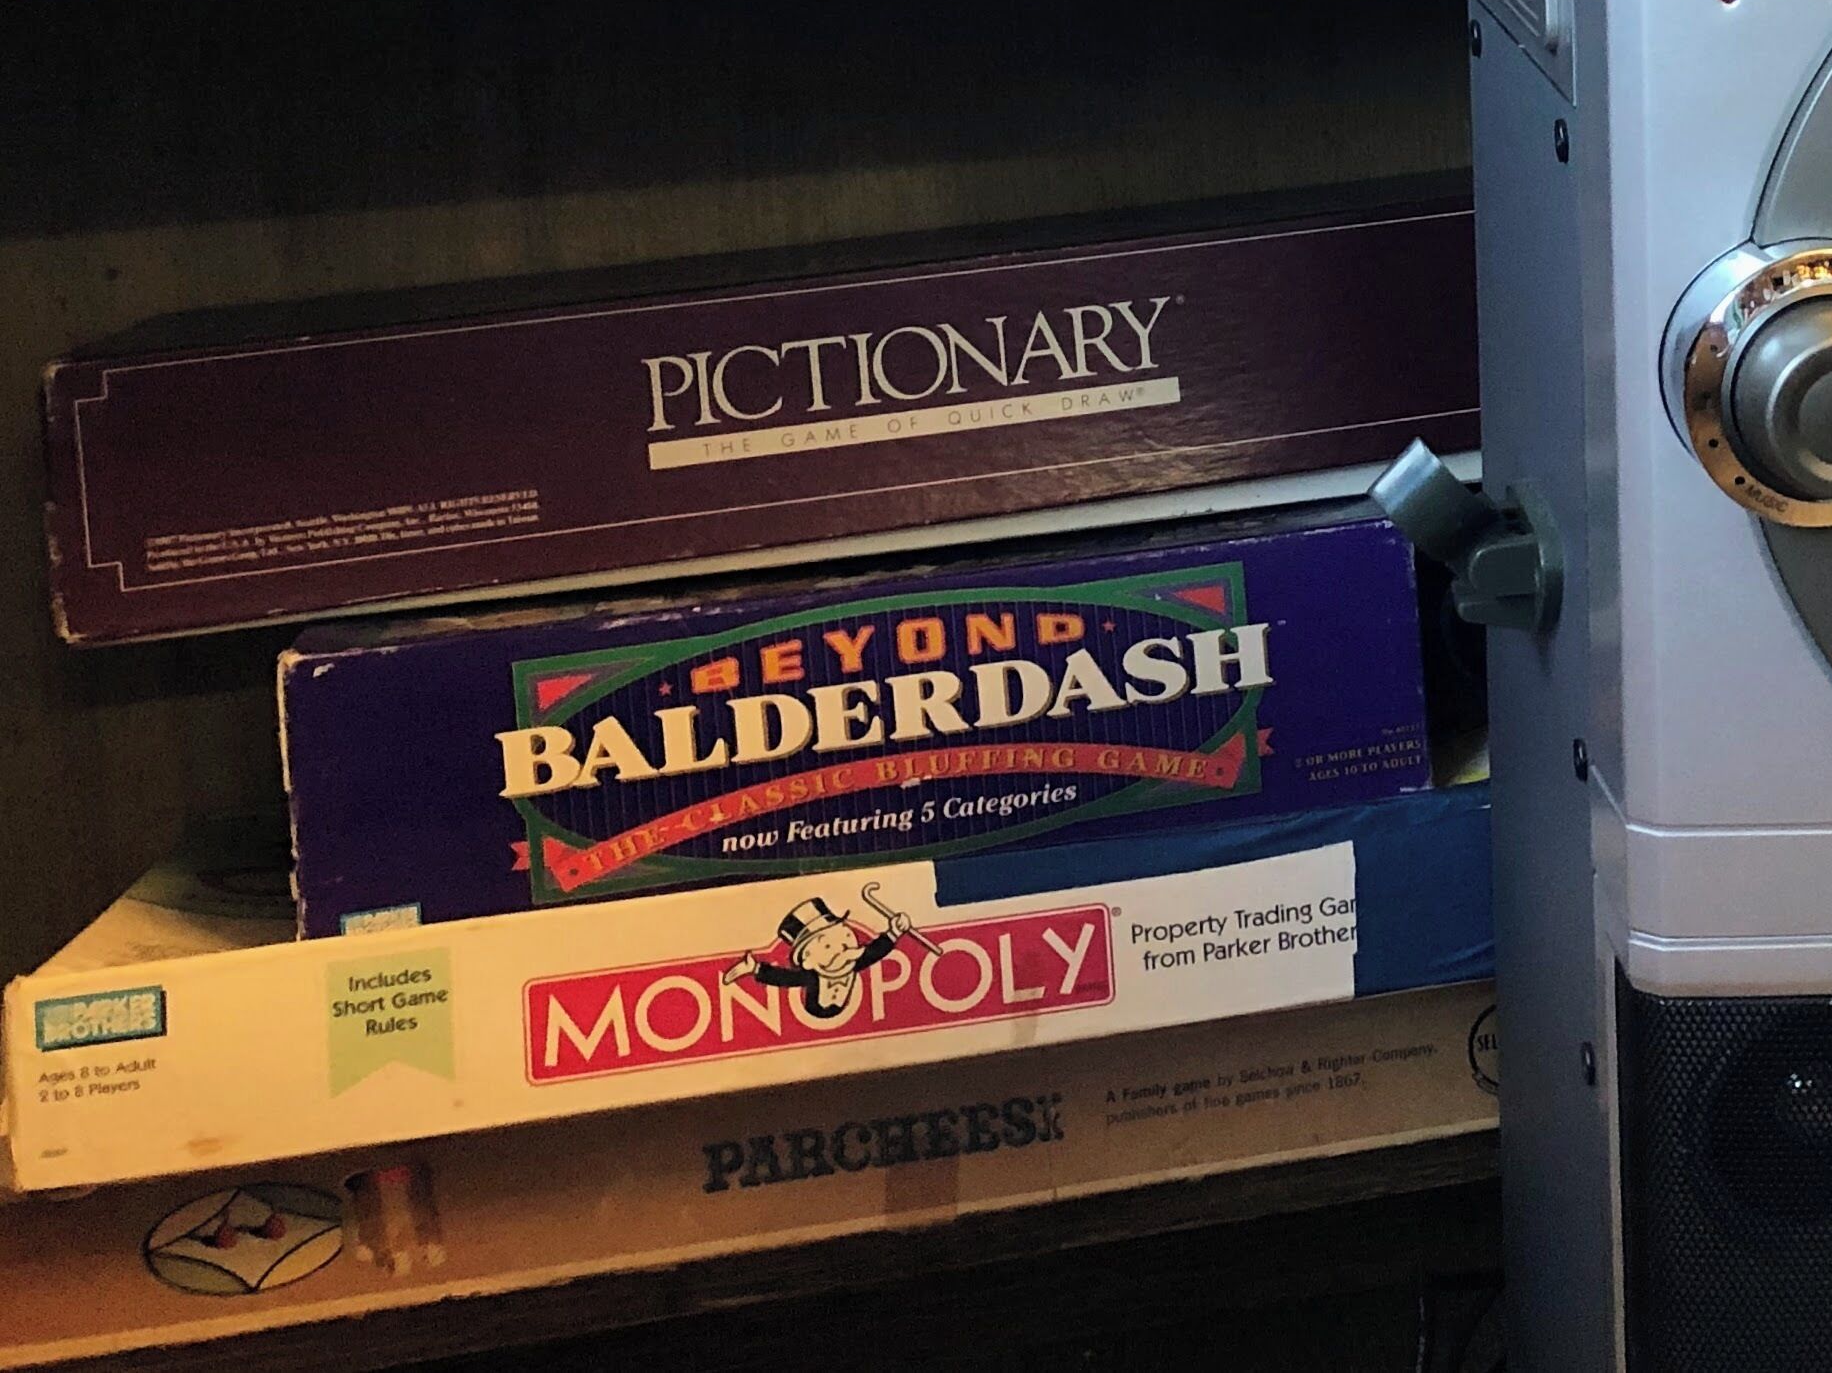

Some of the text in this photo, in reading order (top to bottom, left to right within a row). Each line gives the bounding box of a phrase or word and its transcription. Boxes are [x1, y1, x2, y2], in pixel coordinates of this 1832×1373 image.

[642, 297, 1170, 432] PICTIONARY
[703, 388, 1134, 458] THE GAME OF QUICK DRAW
[1749, 484, 1790, 513] MUSIC
[690, 613, 1087, 695] BEYOND
[497, 623, 1274, 799] BALDERDASH
[1327, 750, 1362, 763] MORE
[1368, 740, 1421, 756] PLAYERS
[1308, 768, 1339, 781] AGES
[1382, 755, 1421, 769] ADULT
[584, 748, 1208, 871] THE CLASSIC BLUFFING GAME
[722, 783, 1077, 853] now Featuring 5 Categories
[1132, 904, 1312, 944] Property Trading
[1143, 937, 1271, 971] from Parker
[348, 968, 432, 992] Includes
[545, 922, 1097, 1067] MONOPOLY
[332, 989, 449, 1017] Short Game
[366, 1016, 418, 1037] Rules
[39, 1067, 75, 1086] Ages
[94, 1064, 110, 1076] to
[115, 1059, 156, 1075] Adult
[54, 1079, 141, 1101] to Players
[1123, 1084, 1168, 1104] Family
[1174, 1079, 1210, 1097] game
[1217, 1074, 1233, 1089] by
[1183, 1088, 1280, 1114] of games
